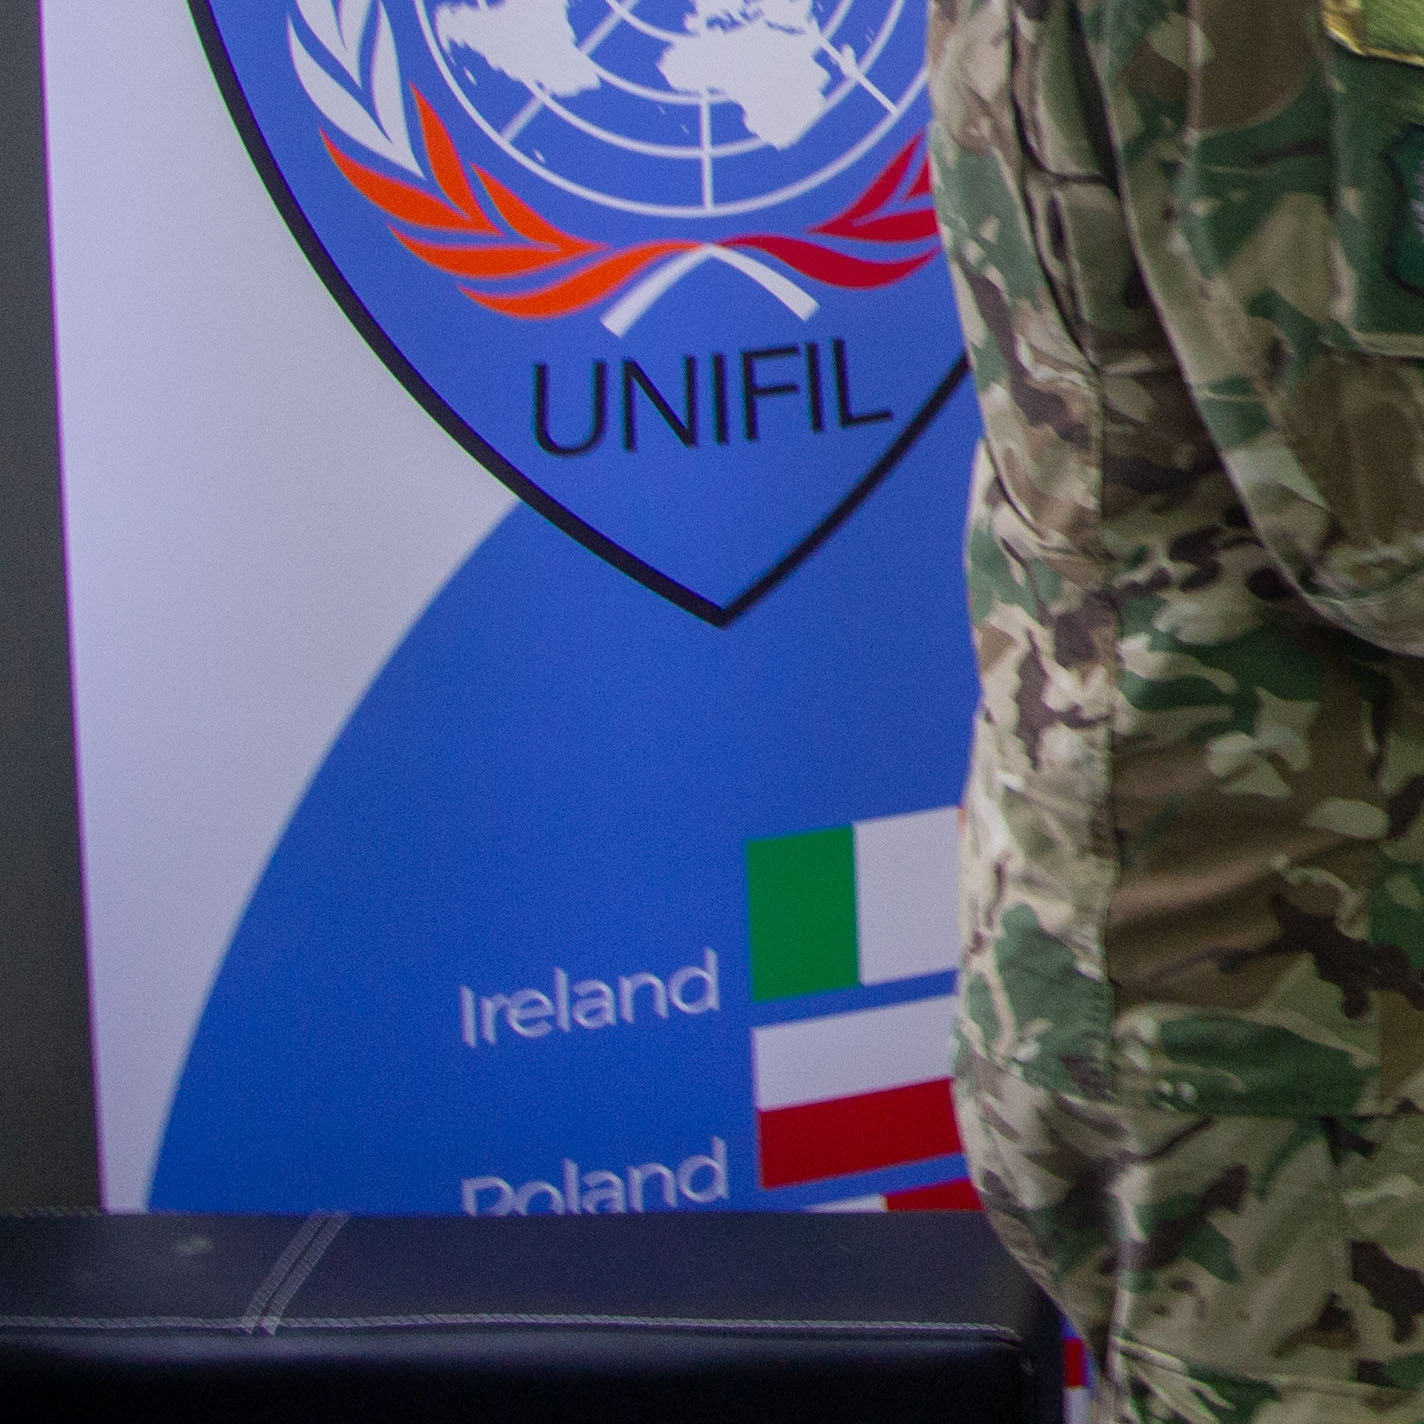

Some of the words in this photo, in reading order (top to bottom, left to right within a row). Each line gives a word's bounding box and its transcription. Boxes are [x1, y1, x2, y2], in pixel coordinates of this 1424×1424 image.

[531, 337, 894, 457] UNIFIL
[459, 947, 721, 1048] Ireland
[460, 1136, 730, 1216] Poland
